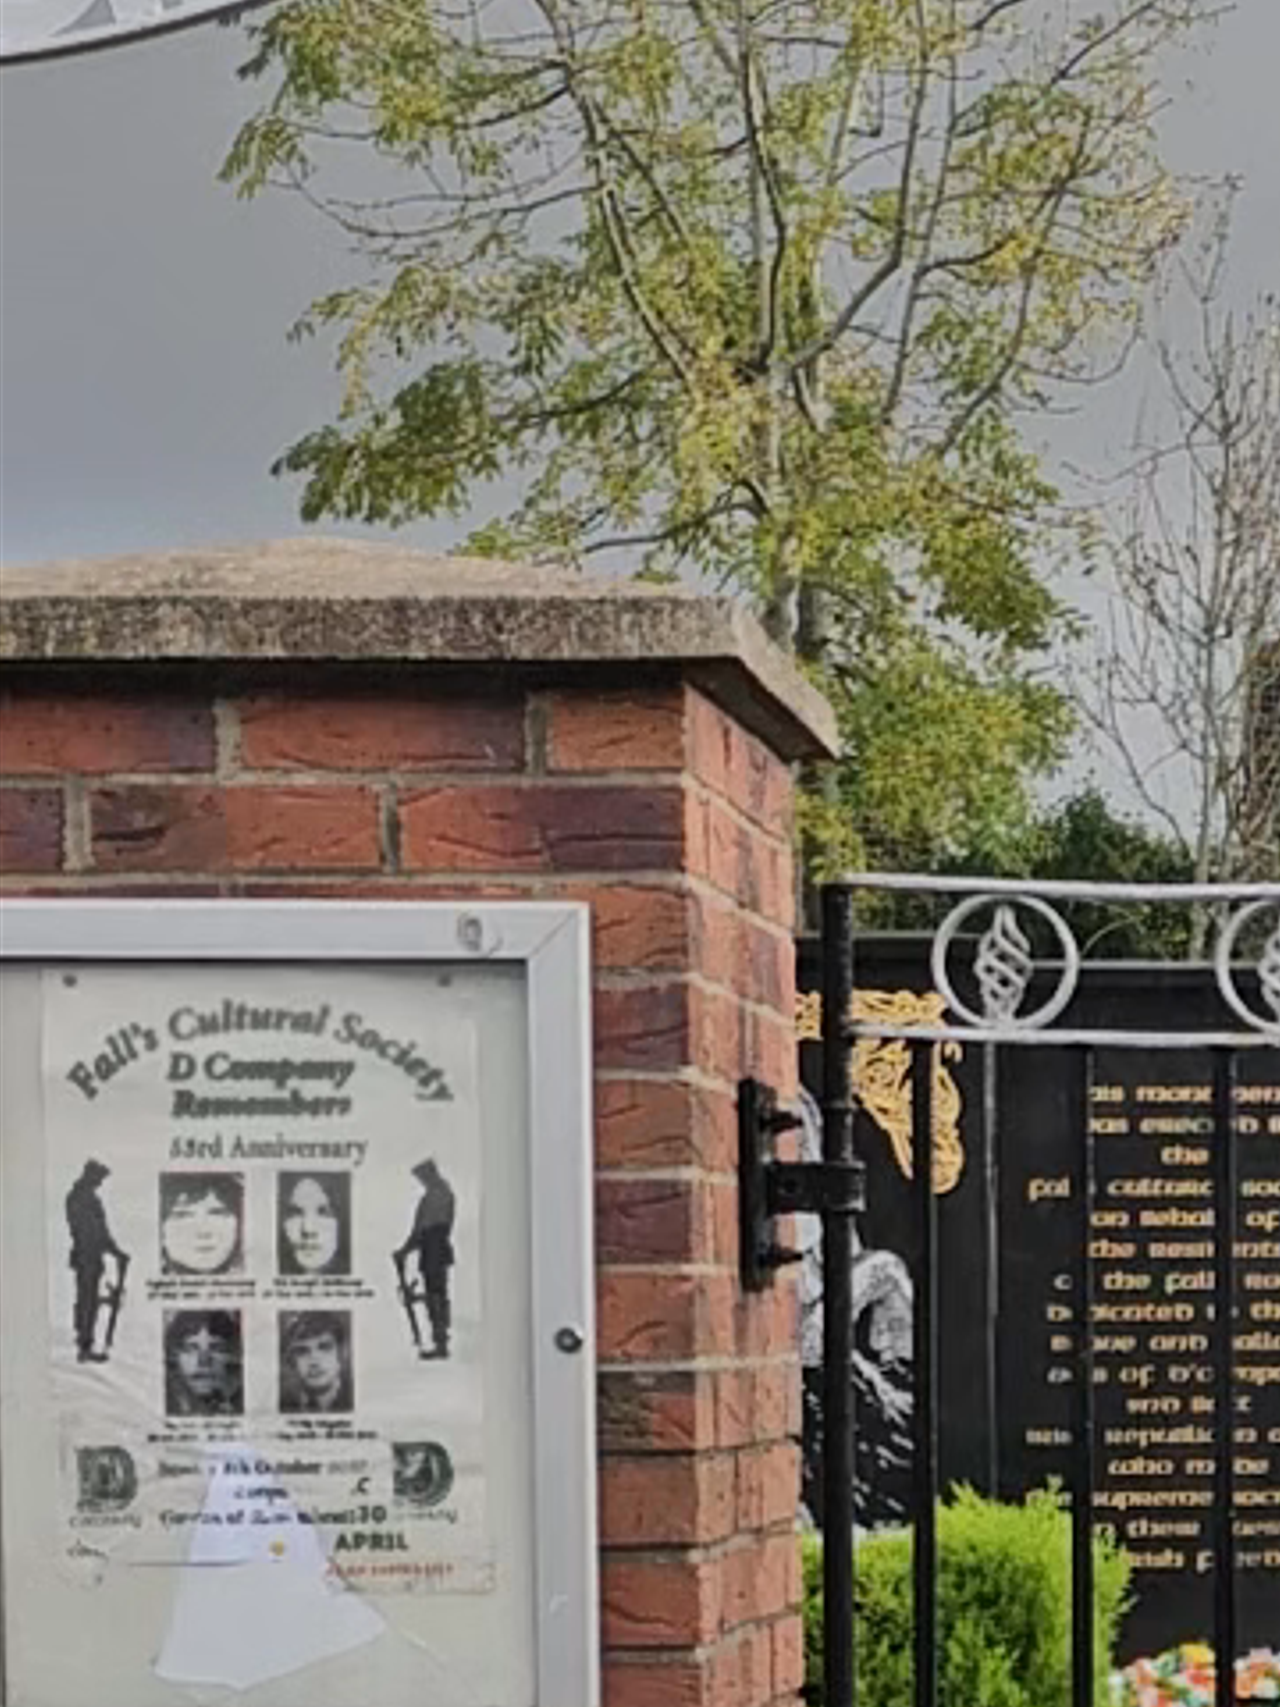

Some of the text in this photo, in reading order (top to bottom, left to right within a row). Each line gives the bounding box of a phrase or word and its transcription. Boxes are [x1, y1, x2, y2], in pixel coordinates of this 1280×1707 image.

[167, 998, 331, 1042] Cultural
[332, 1012, 454, 1101] Society
[166, 1051, 356, 1090] D Company
[169, 1089, 353, 1119] Remembers
[229, 1132, 368, 1166] Anniversary
